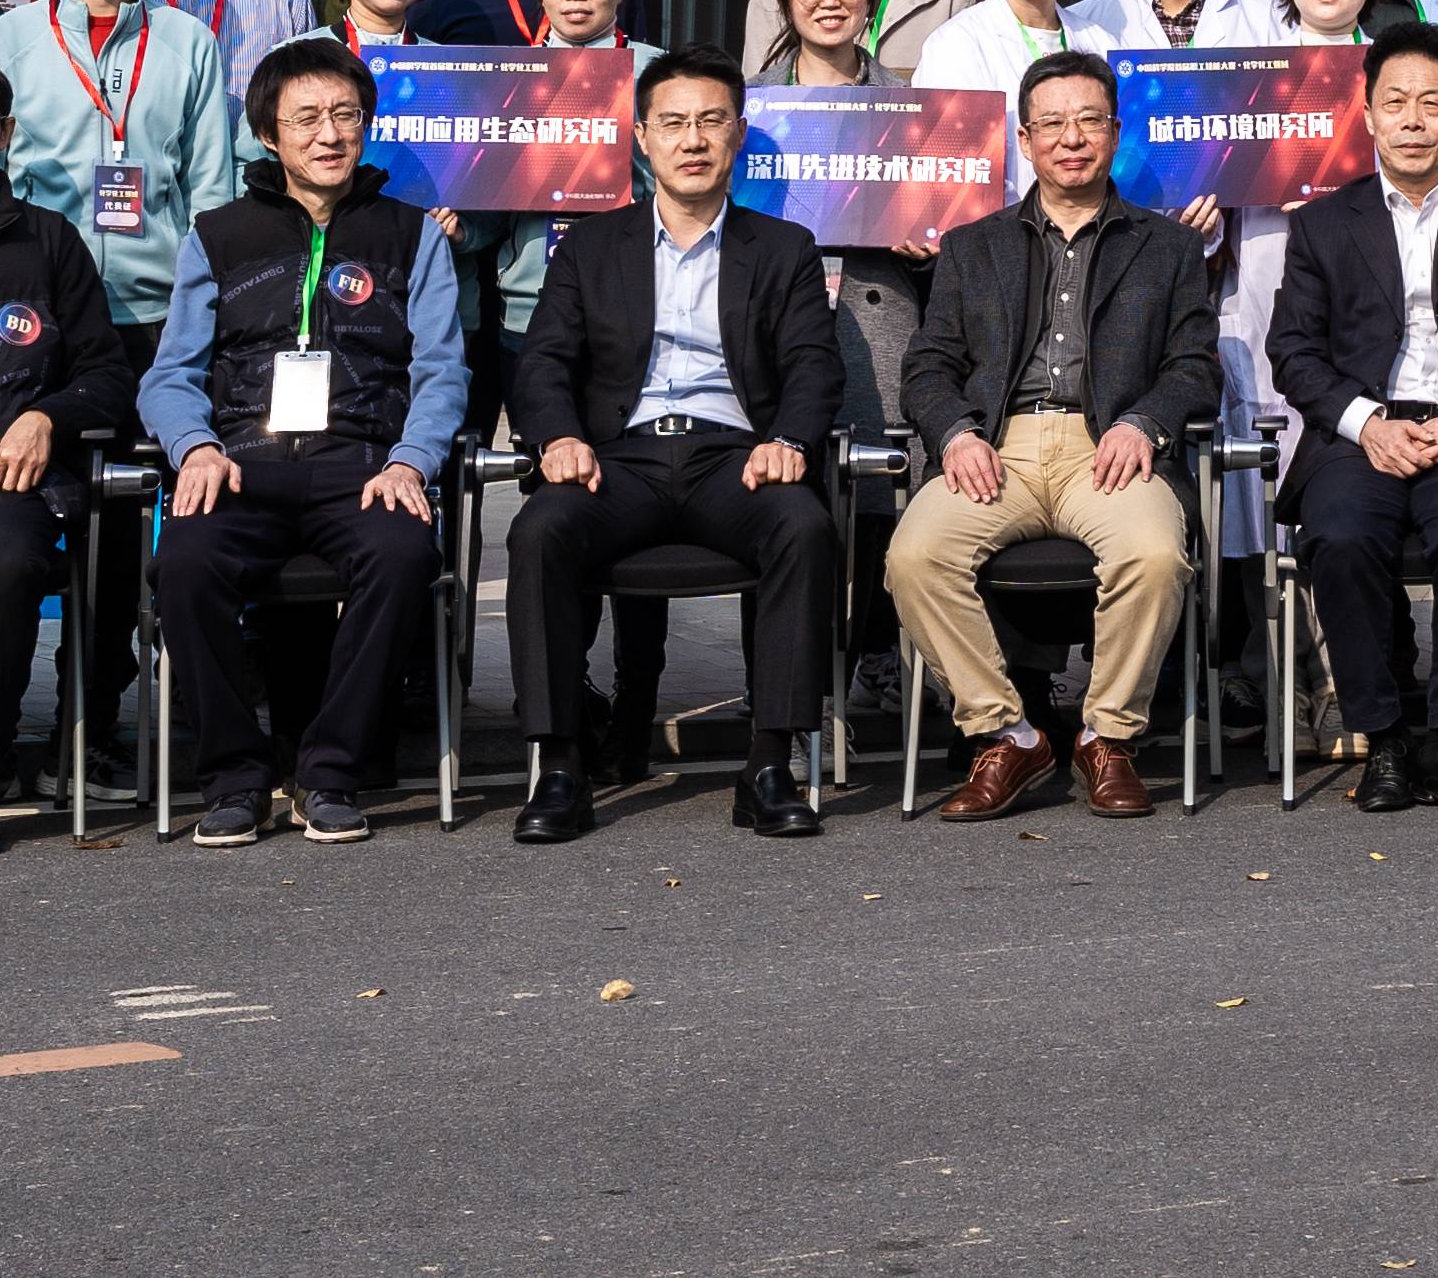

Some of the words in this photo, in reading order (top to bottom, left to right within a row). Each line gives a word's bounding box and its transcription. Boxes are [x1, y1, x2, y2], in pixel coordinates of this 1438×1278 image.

[370, 115, 618, 145] 沈阳应用生态研究所
[1148, 111, 1335, 143] 城市环境研究所
[747, 153, 991, 185] 深圳先进技术研究院
[221, 265, 286, 305] DBBTALOSE
[337, 273, 365, 294] FH
[6, 314, 32, 333] BD
